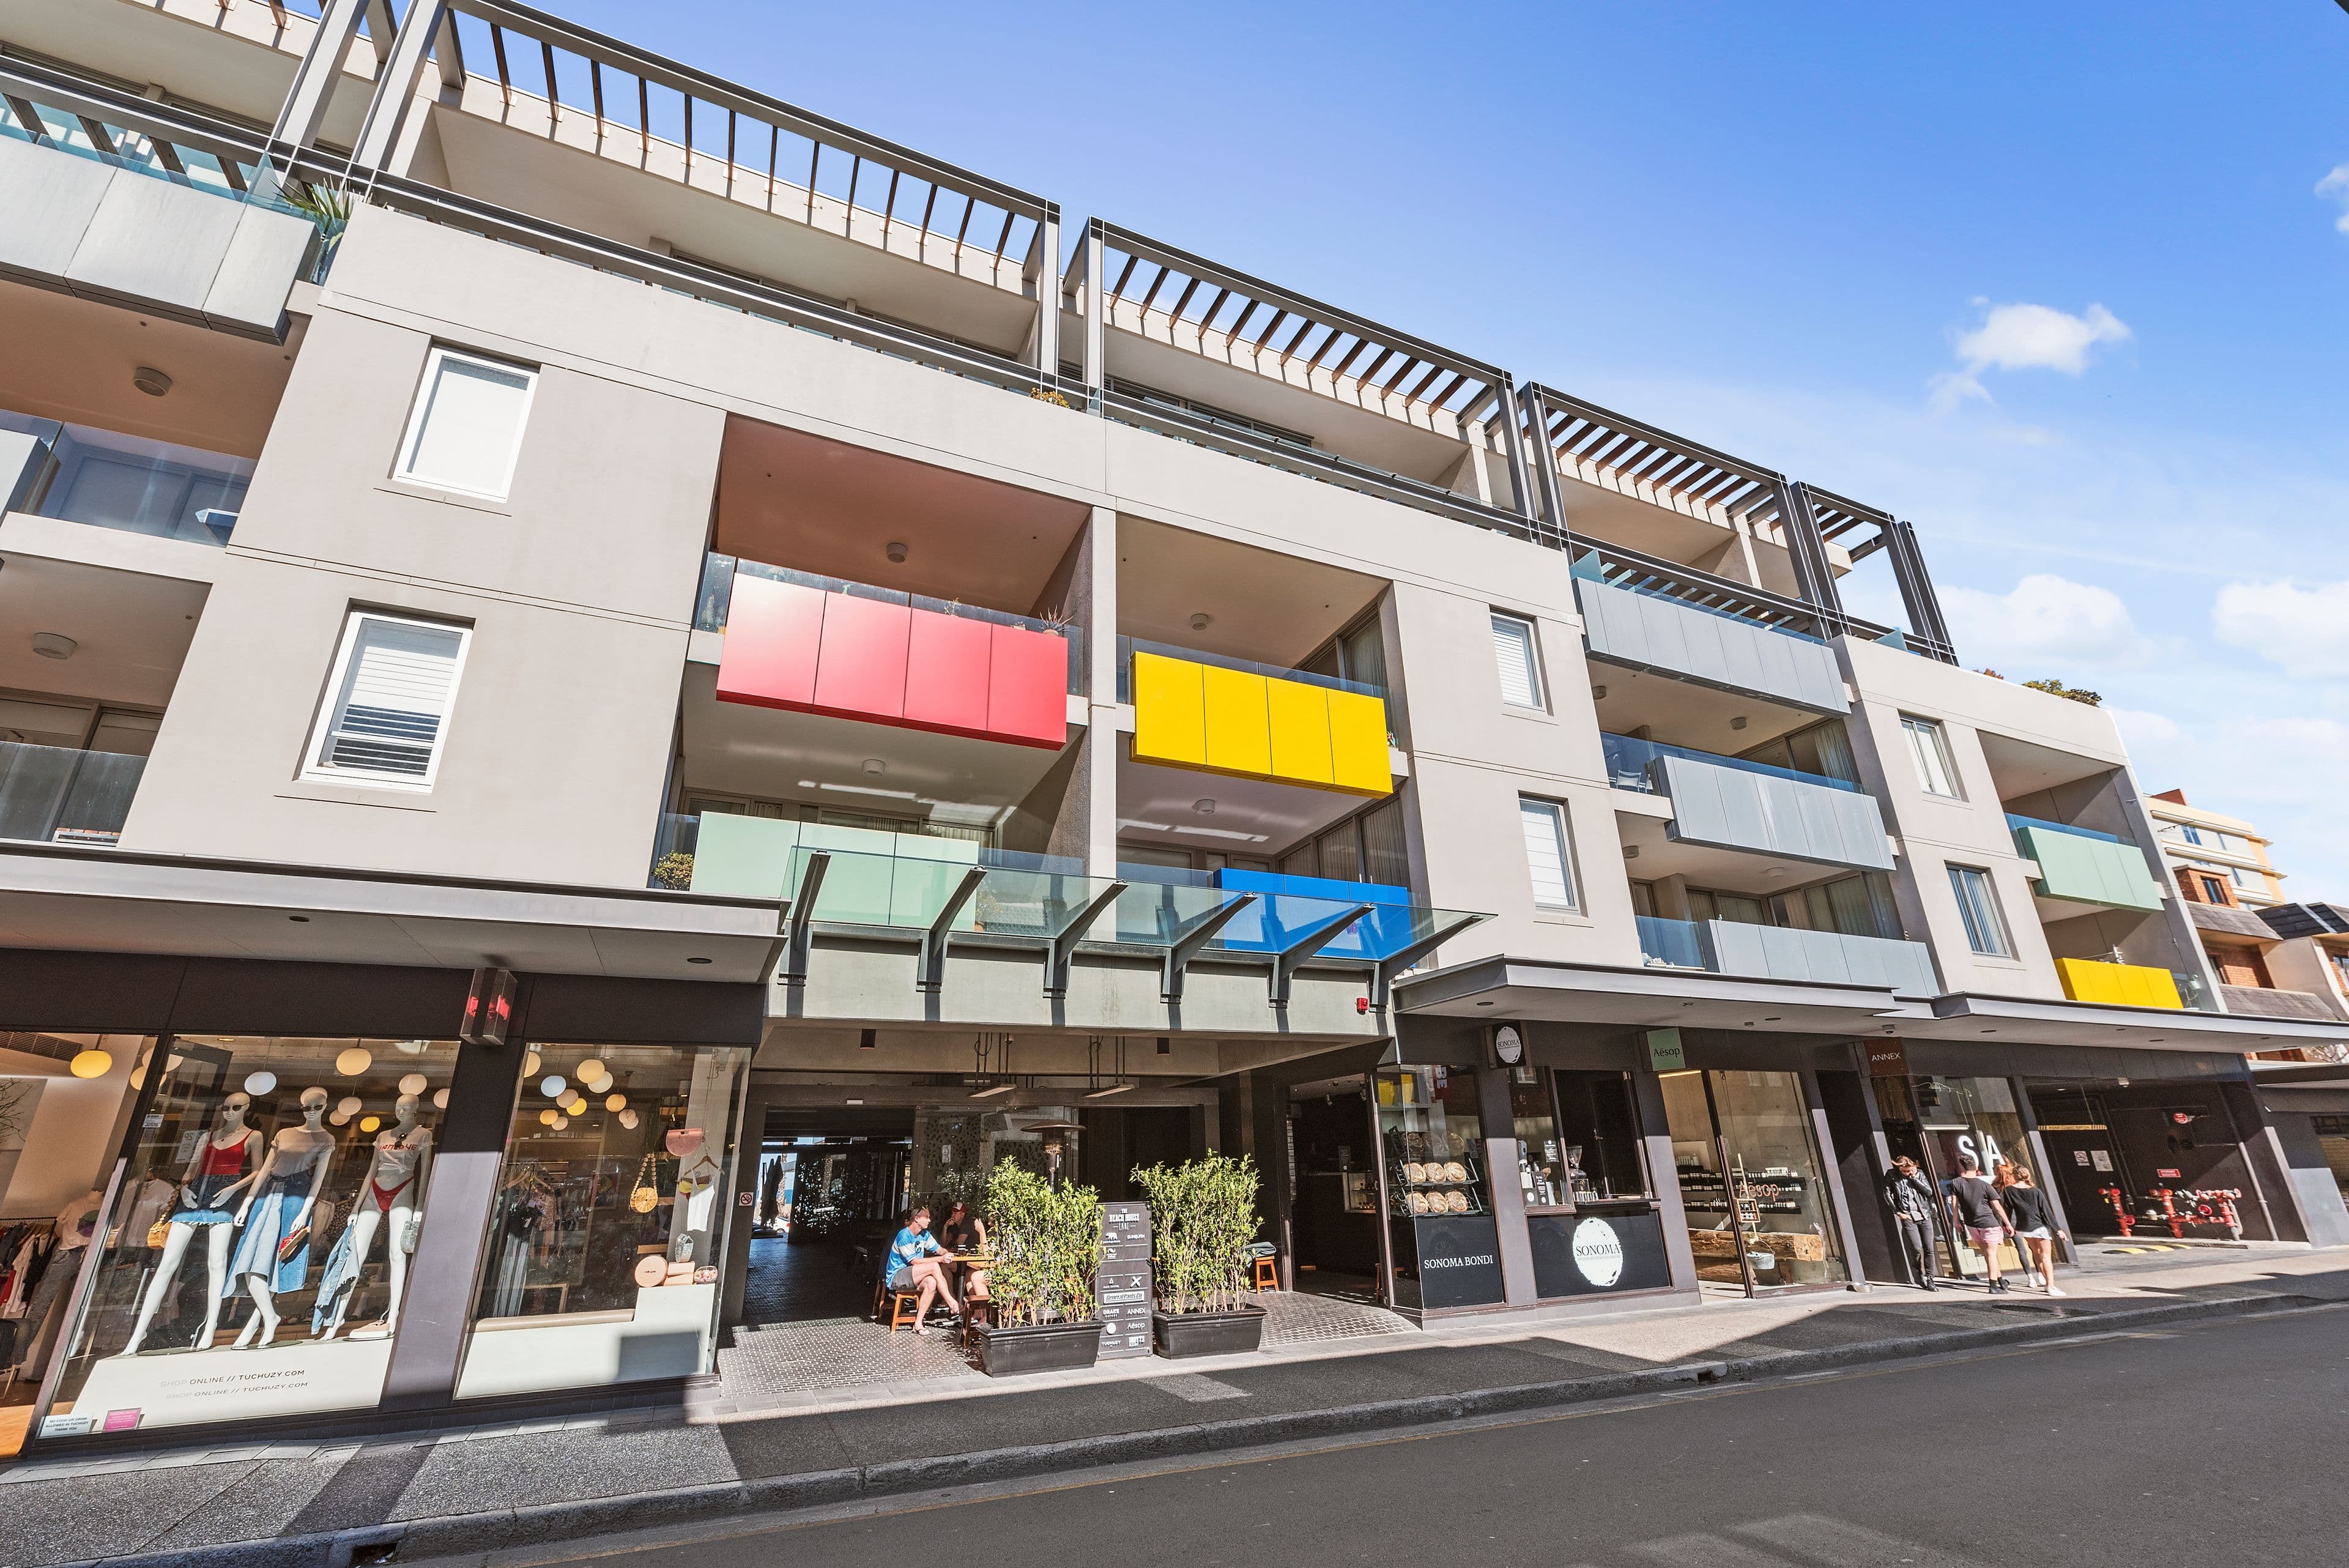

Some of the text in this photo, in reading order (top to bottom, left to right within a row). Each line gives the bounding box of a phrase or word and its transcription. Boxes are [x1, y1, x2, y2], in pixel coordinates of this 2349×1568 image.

[1872, 1052, 1901, 1061] ANNEX
[1109, 1213, 1140, 1222] BEACH HOUSE
[1576, 1244, 1620, 1256] SONOMA
[1424, 1255, 1493, 1269] SONOMA BONDI
[190, 1377, 225, 1385] ONLINE
[239, 1370, 305, 1380] TUCHUZY.COM
